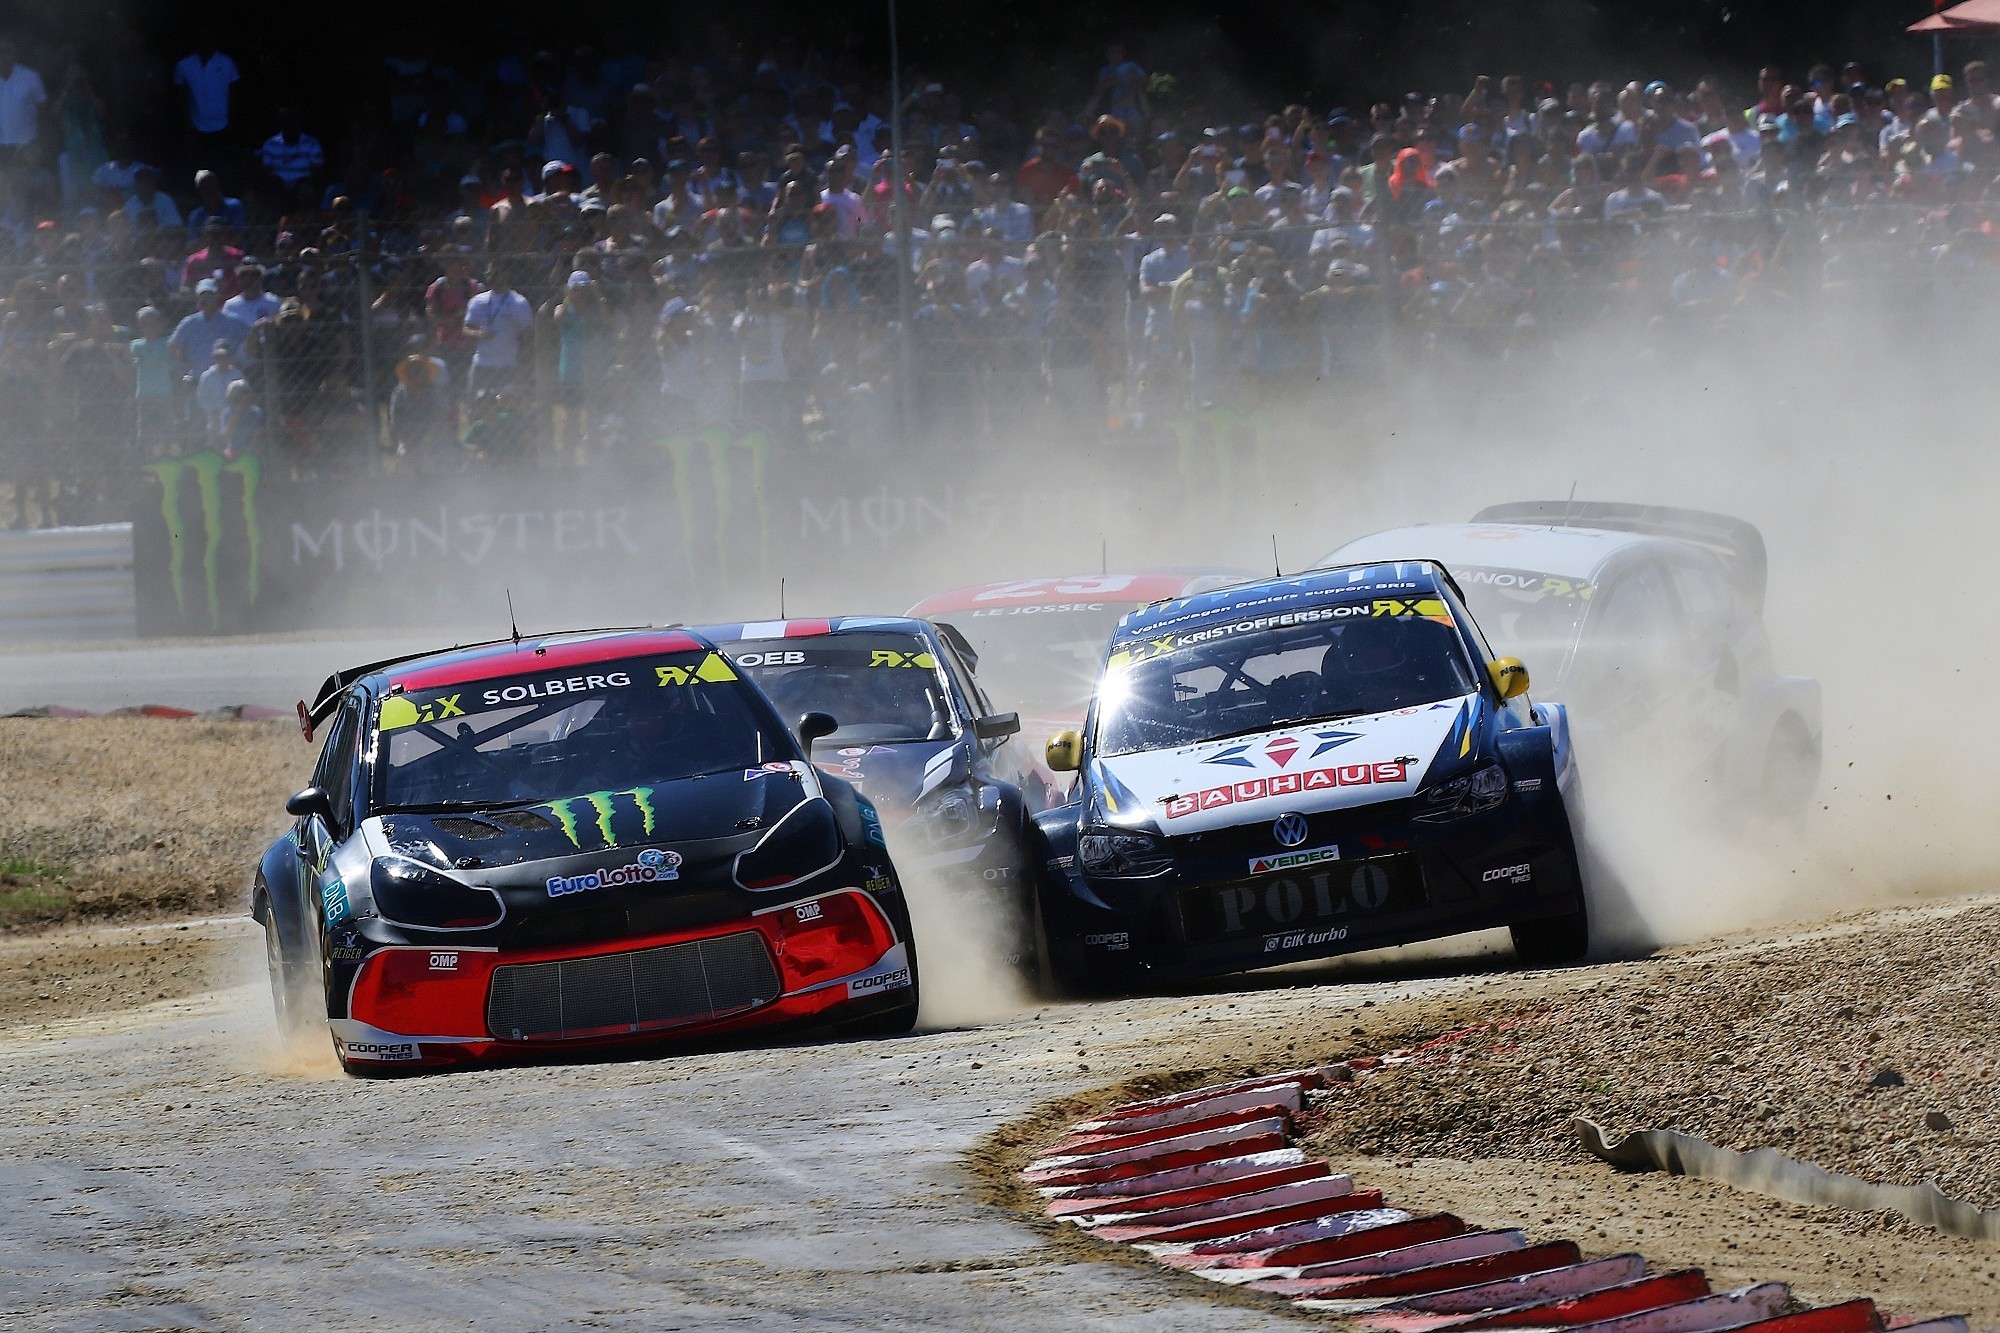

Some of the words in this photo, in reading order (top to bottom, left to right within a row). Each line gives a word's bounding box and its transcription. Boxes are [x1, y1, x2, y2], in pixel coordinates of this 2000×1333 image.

[291, 505, 641, 572] MONSTER
[973, 608, 1004, 617] LE
[1008, 603, 1104, 615] JOSSEC
[1131, 606, 1232, 636] Volkswagen
[1236, 593, 1299, 609] Dealers
[1305, 584, 1371, 596] support
[1177, 605, 1370, 647] KRISTOFFERSSON
[735, 650, 806, 667] OEB
[483, 672, 632, 706] SOLBERG
[1170, 763, 1402, 815] BAUHAUS
[1482, 863, 1531, 882] COOPER
[1509, 873, 1532, 884] TIRES
[324, 880, 347, 921] DNB
[1219, 864, 1388, 933] POLO
[796, 904, 822, 919] OMP
[1085, 932, 1129, 945] COOPER
[1307, 927, 1347, 945] turbo
[429, 955, 458, 968] OMP
[852, 968, 908, 991] COOPER
[883, 979, 909, 991] TIRES
[348, 1043, 413, 1053] COOPER
[378, 1052, 414, 1060] TIRES
